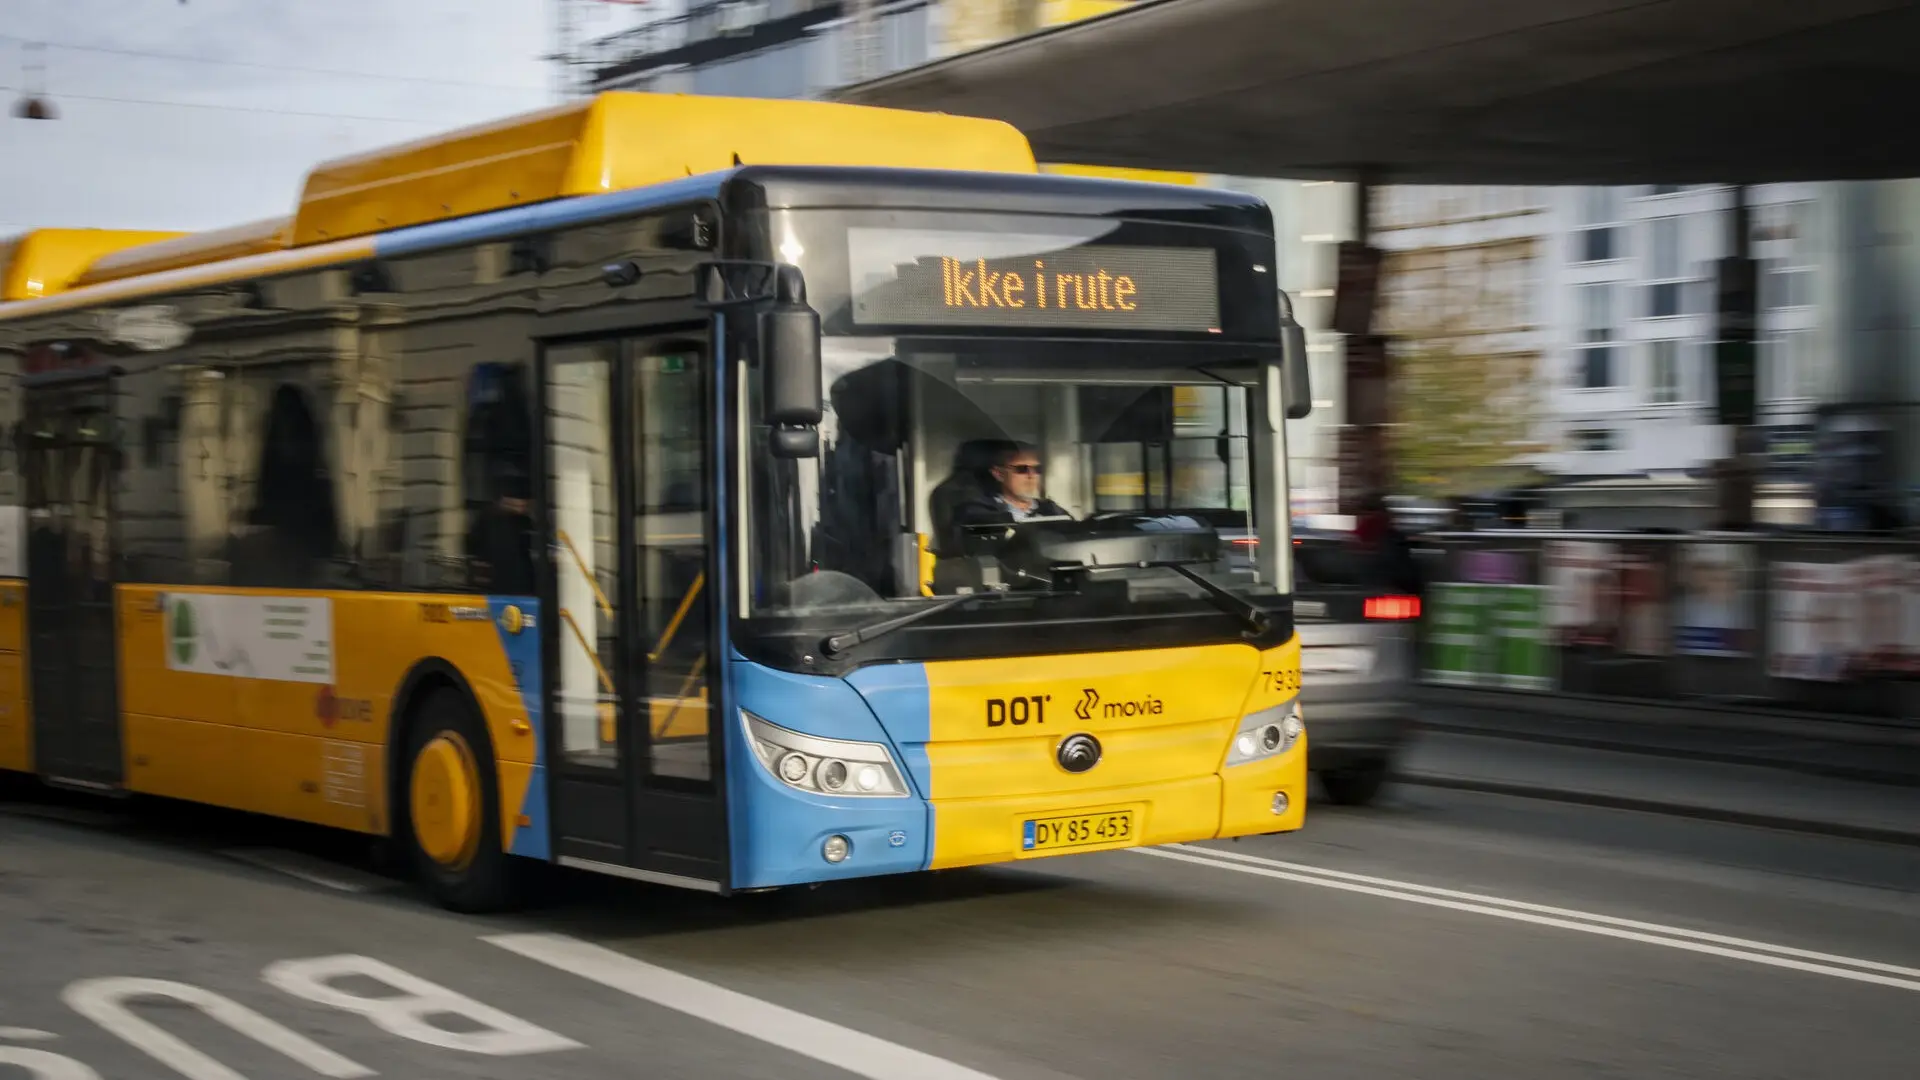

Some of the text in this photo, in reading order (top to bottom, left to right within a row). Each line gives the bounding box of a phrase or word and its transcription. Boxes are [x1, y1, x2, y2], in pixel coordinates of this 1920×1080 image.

[941, 256, 1137, 310] Ikke i rute
[987, 695, 1049, 727] DOT
[1104, 694, 1163, 718] movia
[1036, 815, 1130, 844] DY 85 453
